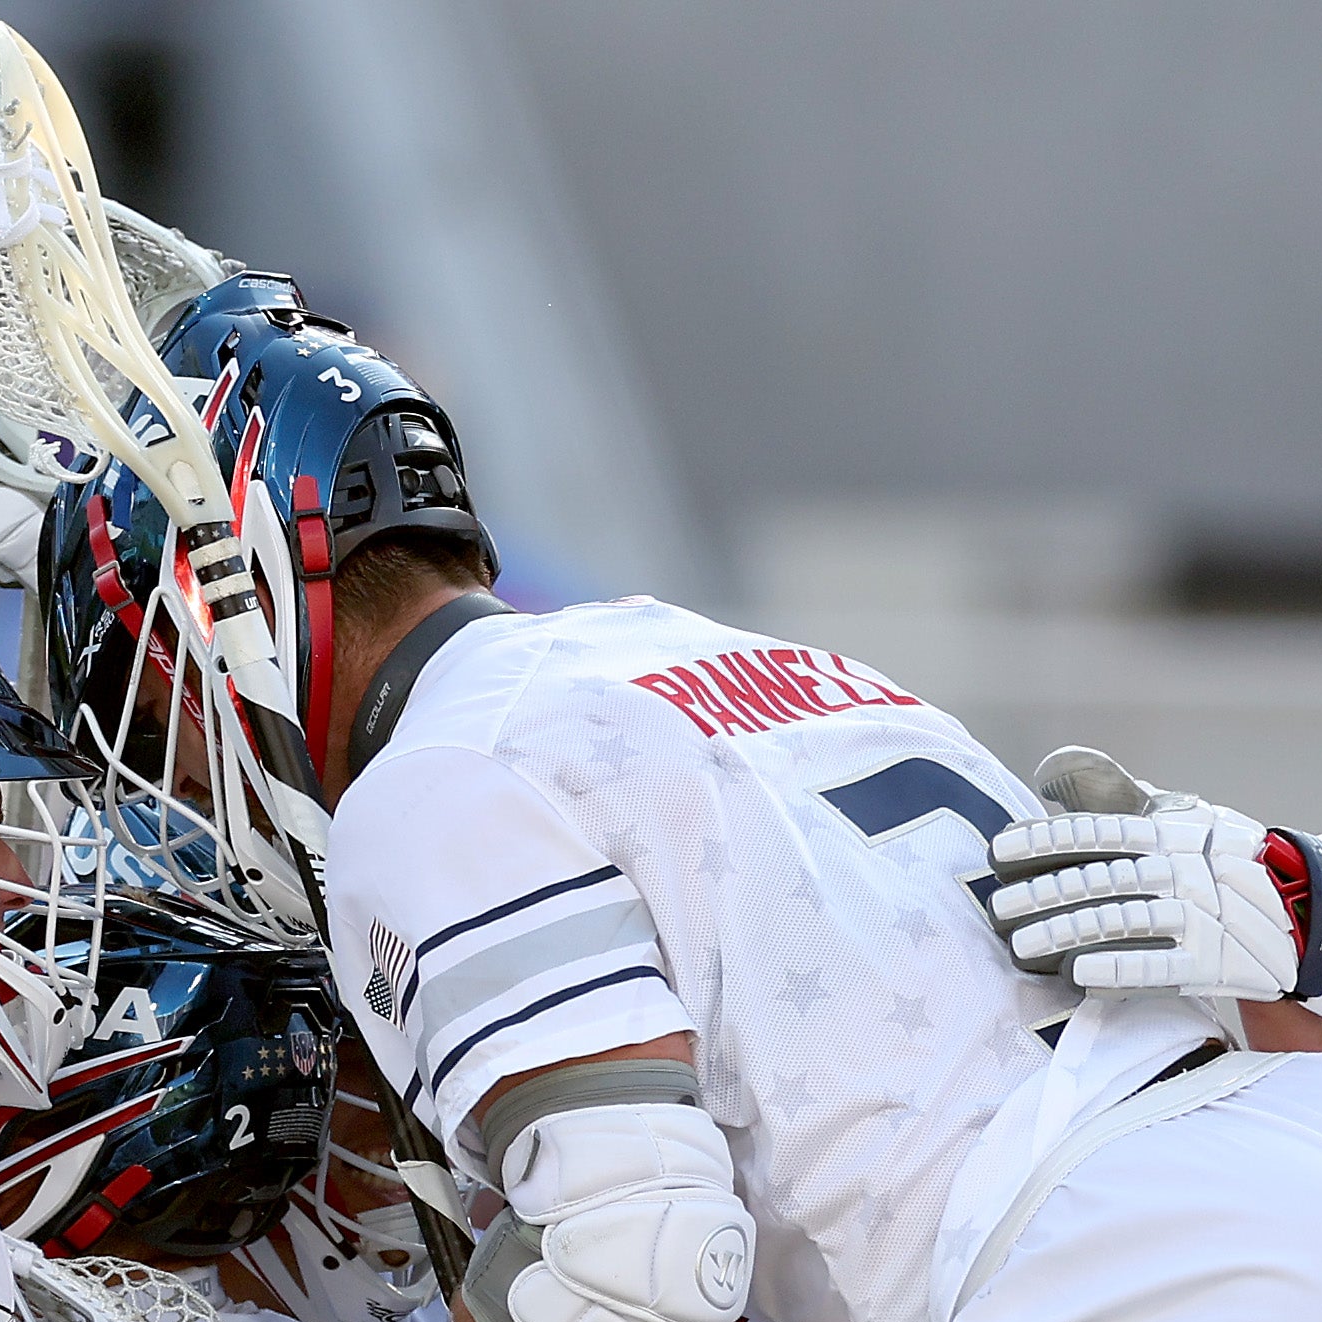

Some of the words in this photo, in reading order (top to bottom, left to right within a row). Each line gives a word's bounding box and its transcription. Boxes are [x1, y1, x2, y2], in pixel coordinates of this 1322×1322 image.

[317, 366, 363, 403] 3
[627, 648, 926, 739] PANNELL
[224, 1104, 256, 1151] 2
